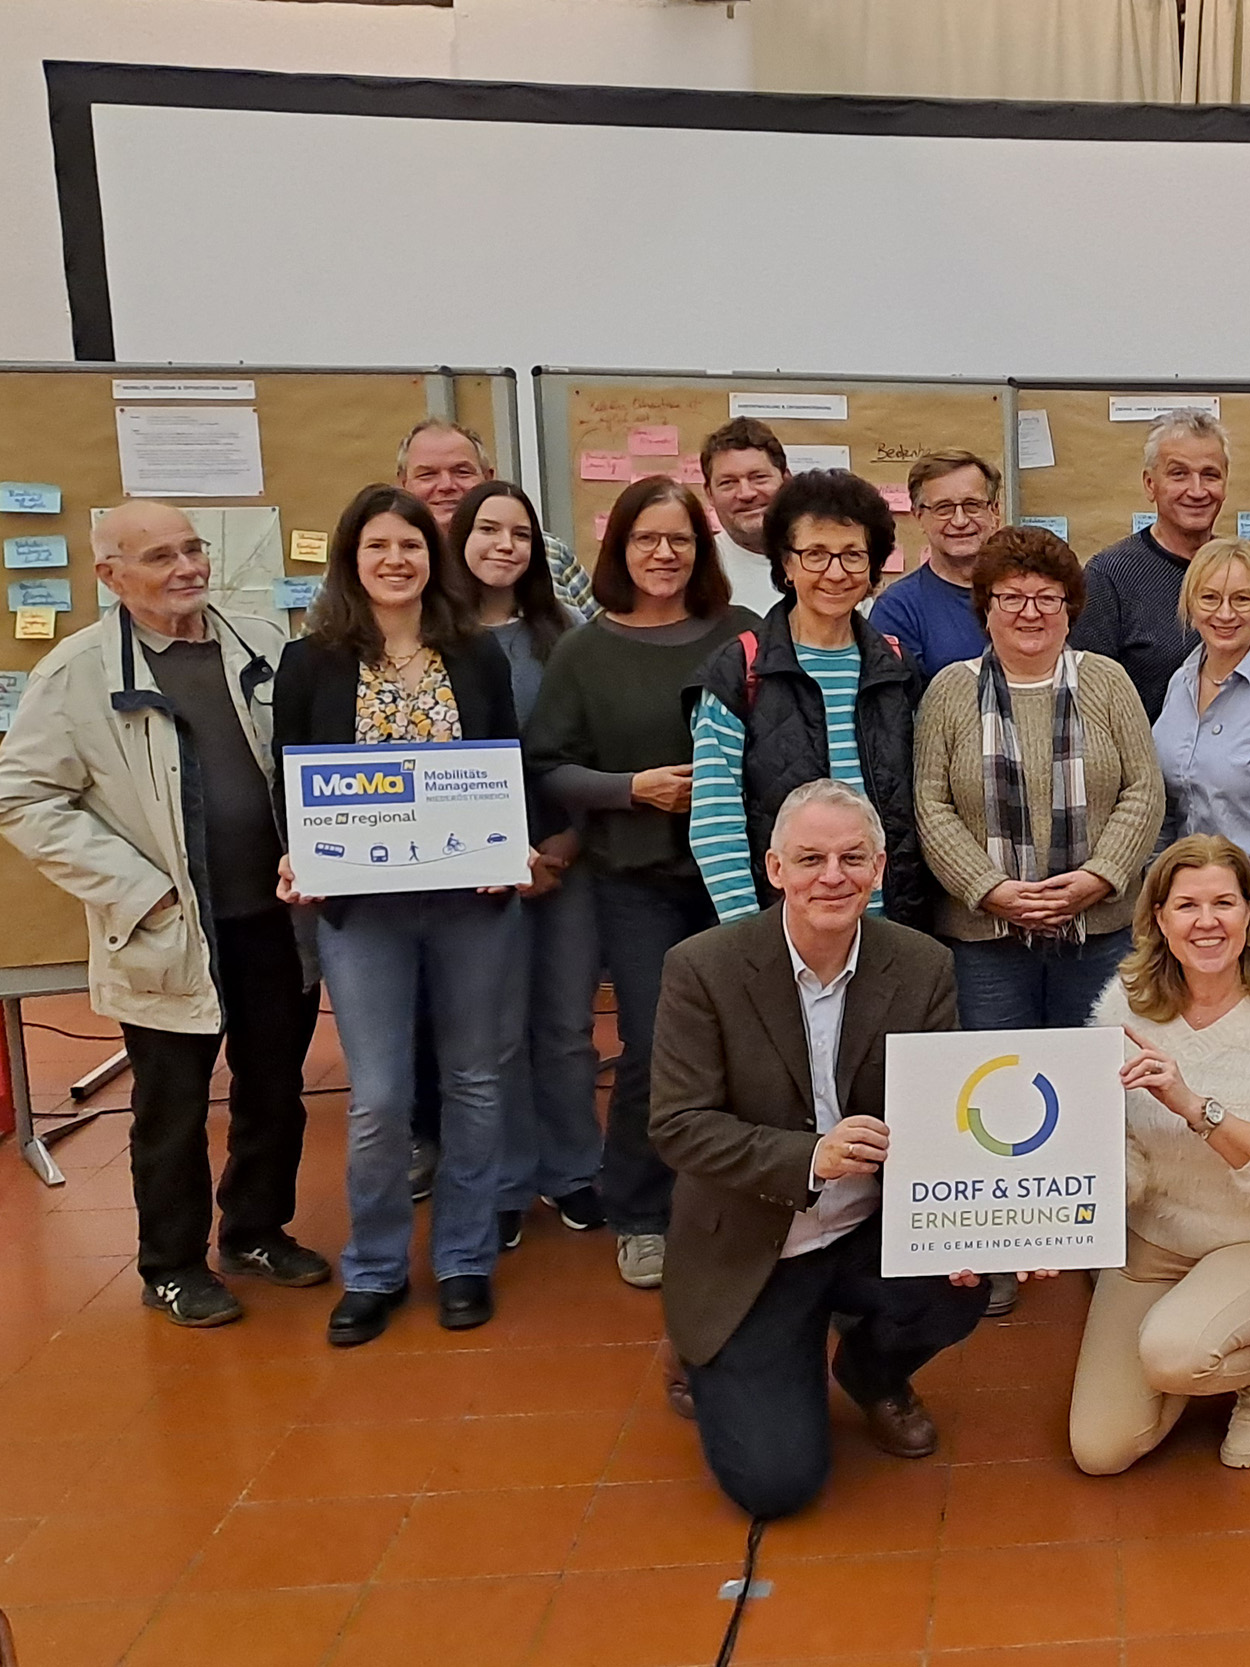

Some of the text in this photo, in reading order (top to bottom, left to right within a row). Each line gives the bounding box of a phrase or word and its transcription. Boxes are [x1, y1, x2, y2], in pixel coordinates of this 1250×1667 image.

[312, 771, 405, 797] MoMa
[424, 769, 488, 781] Mobilitäts
[425, 780, 509, 793] Management
[304, 816, 333, 827] noe
[352, 809, 417, 828] regional
[912, 1175, 1096, 1202] DORF & STADT
[911, 1206, 1070, 1229] ERNEUERUNG
[910, 1235, 1094, 1252] DIE GEMEINDEAGENTUR
